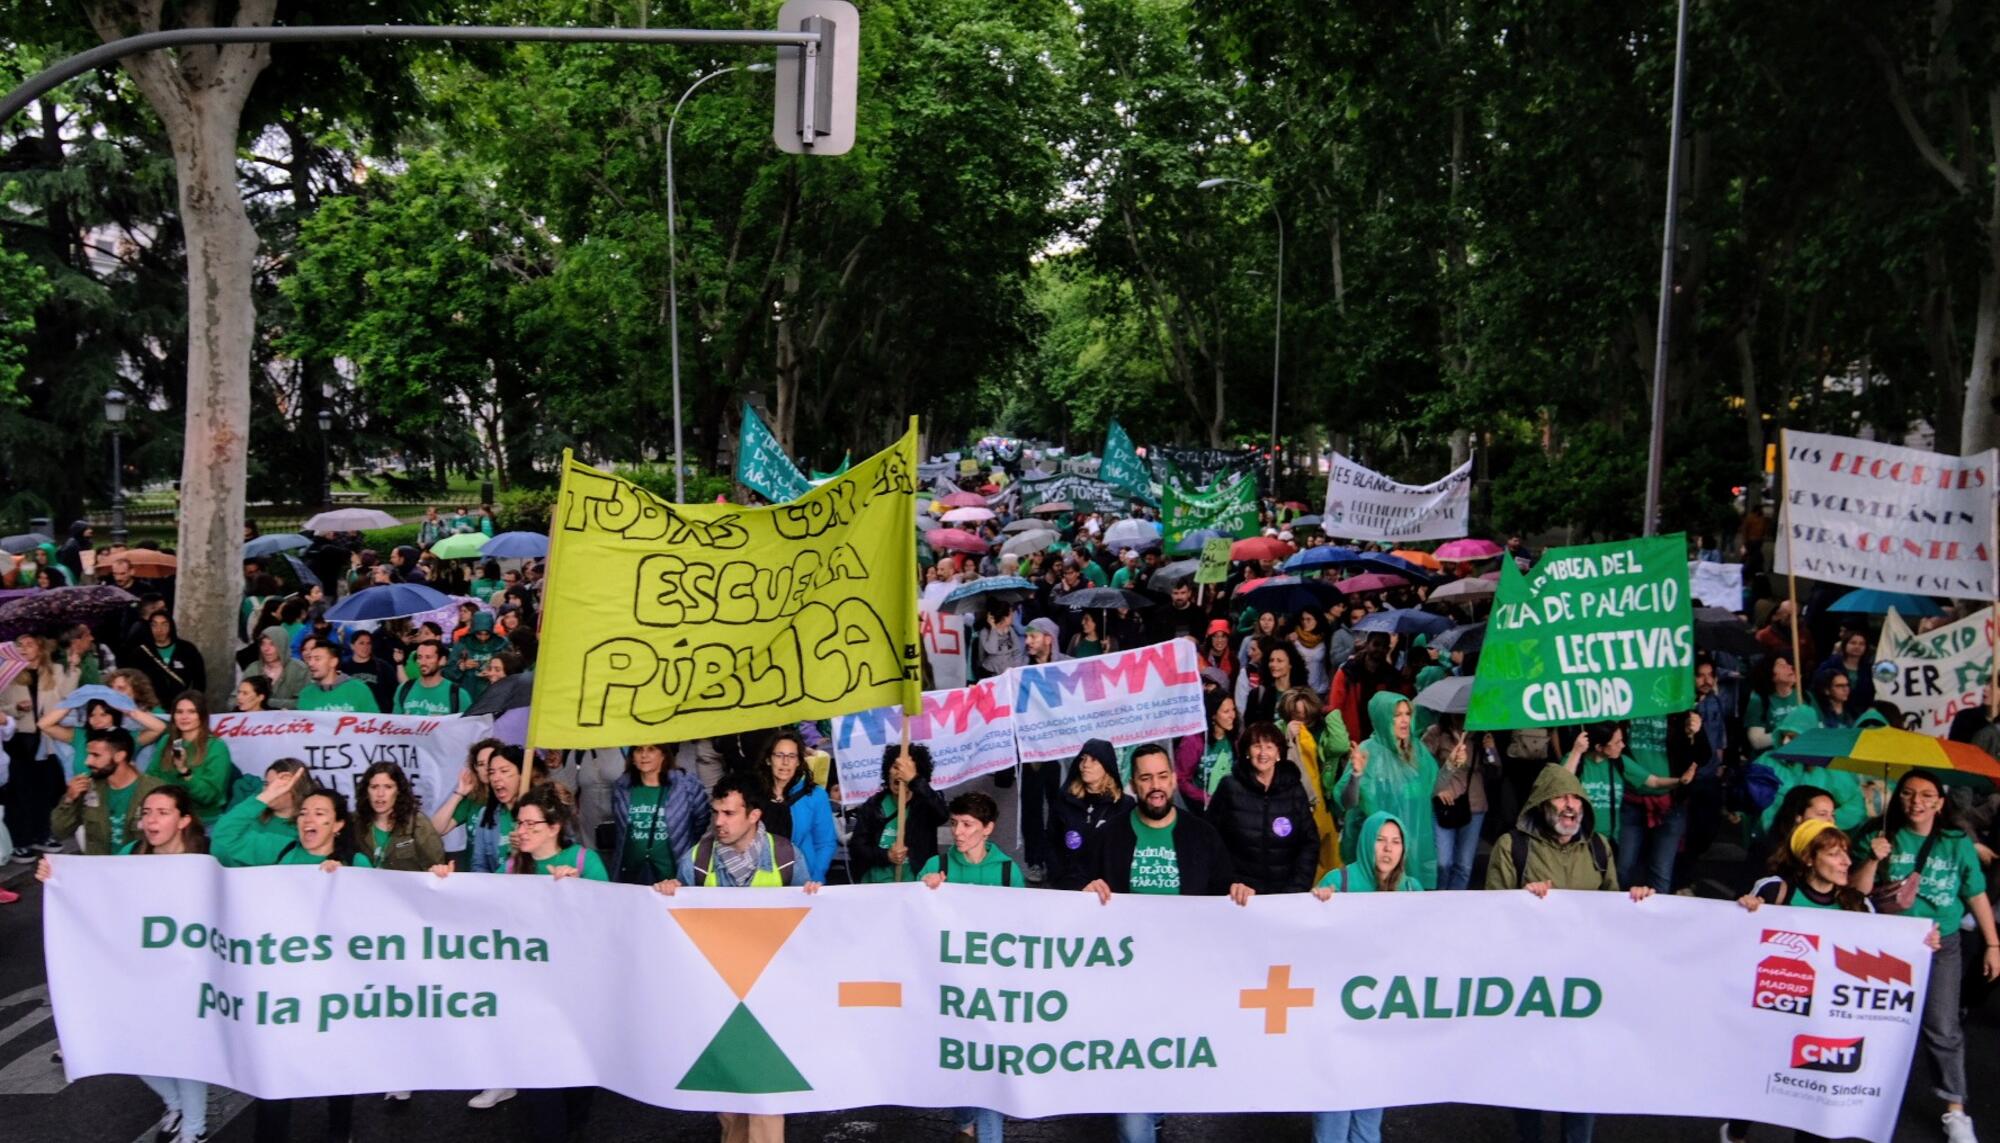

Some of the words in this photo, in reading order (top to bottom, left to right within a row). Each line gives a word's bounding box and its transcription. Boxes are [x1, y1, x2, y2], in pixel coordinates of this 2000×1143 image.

[1352, 471, 1397, 495] BLANCA
[1789, 445, 1823, 464] LOS
[1829, 451, 1985, 489] RECORTES
[1601, 550, 1643, 578] DEL
[1856, 532, 1989, 562] CONTRA
[1543, 591, 1575, 624] DE
[1582, 578, 1679, 619] PALACIO
[577, 597, 905, 728] PÚBLICA
[1555, 625, 1692, 675] LECTIVAS
[1018, 716, 1076, 733] ASOCIACIÓN
[1077, 704, 1135, 723] MADRILEÑA
[1136, 702, 1150, 713] DE
[1151, 693, 1201, 709] MAESTRAS
[1521, 676, 1634, 722] CALIDAD
[212, 715, 316, 739] Educación
[334, 714, 441, 738] Pública!!!
[1029, 726, 1079, 741] MAESTROS
[1080, 723, 1093, 732] DE
[1095, 713, 1143, 730] AUDICIÓN
[1152, 704, 1200, 720] LENGUAJE
[359, 743, 420, 770] VISTA
[141, 915, 333, 966] Docentes
[349, 931, 406, 962] en
[422, 926, 551, 963] lucha
[938, 930, 1135, 970] LECTIVAS
[938, 985, 1068, 1024] RATIO
[1340, 974, 1603, 1021] CALIDAD
[1756, 990, 1810, 1014] CGT
[1759, 979, 1808, 993] MADRID
[1831, 984, 1915, 1013] STEM
[198, 981, 244, 1025] por
[256, 990, 300, 1025] la
[318, 984, 499, 1032] pública
[938, 1035, 1217, 1076] BUROCRACIA
[1800, 1044, 1856, 1066] CNT
[1773, 1072, 1827, 1094] Sección
[1831, 1084, 1882, 1098] Sindical
